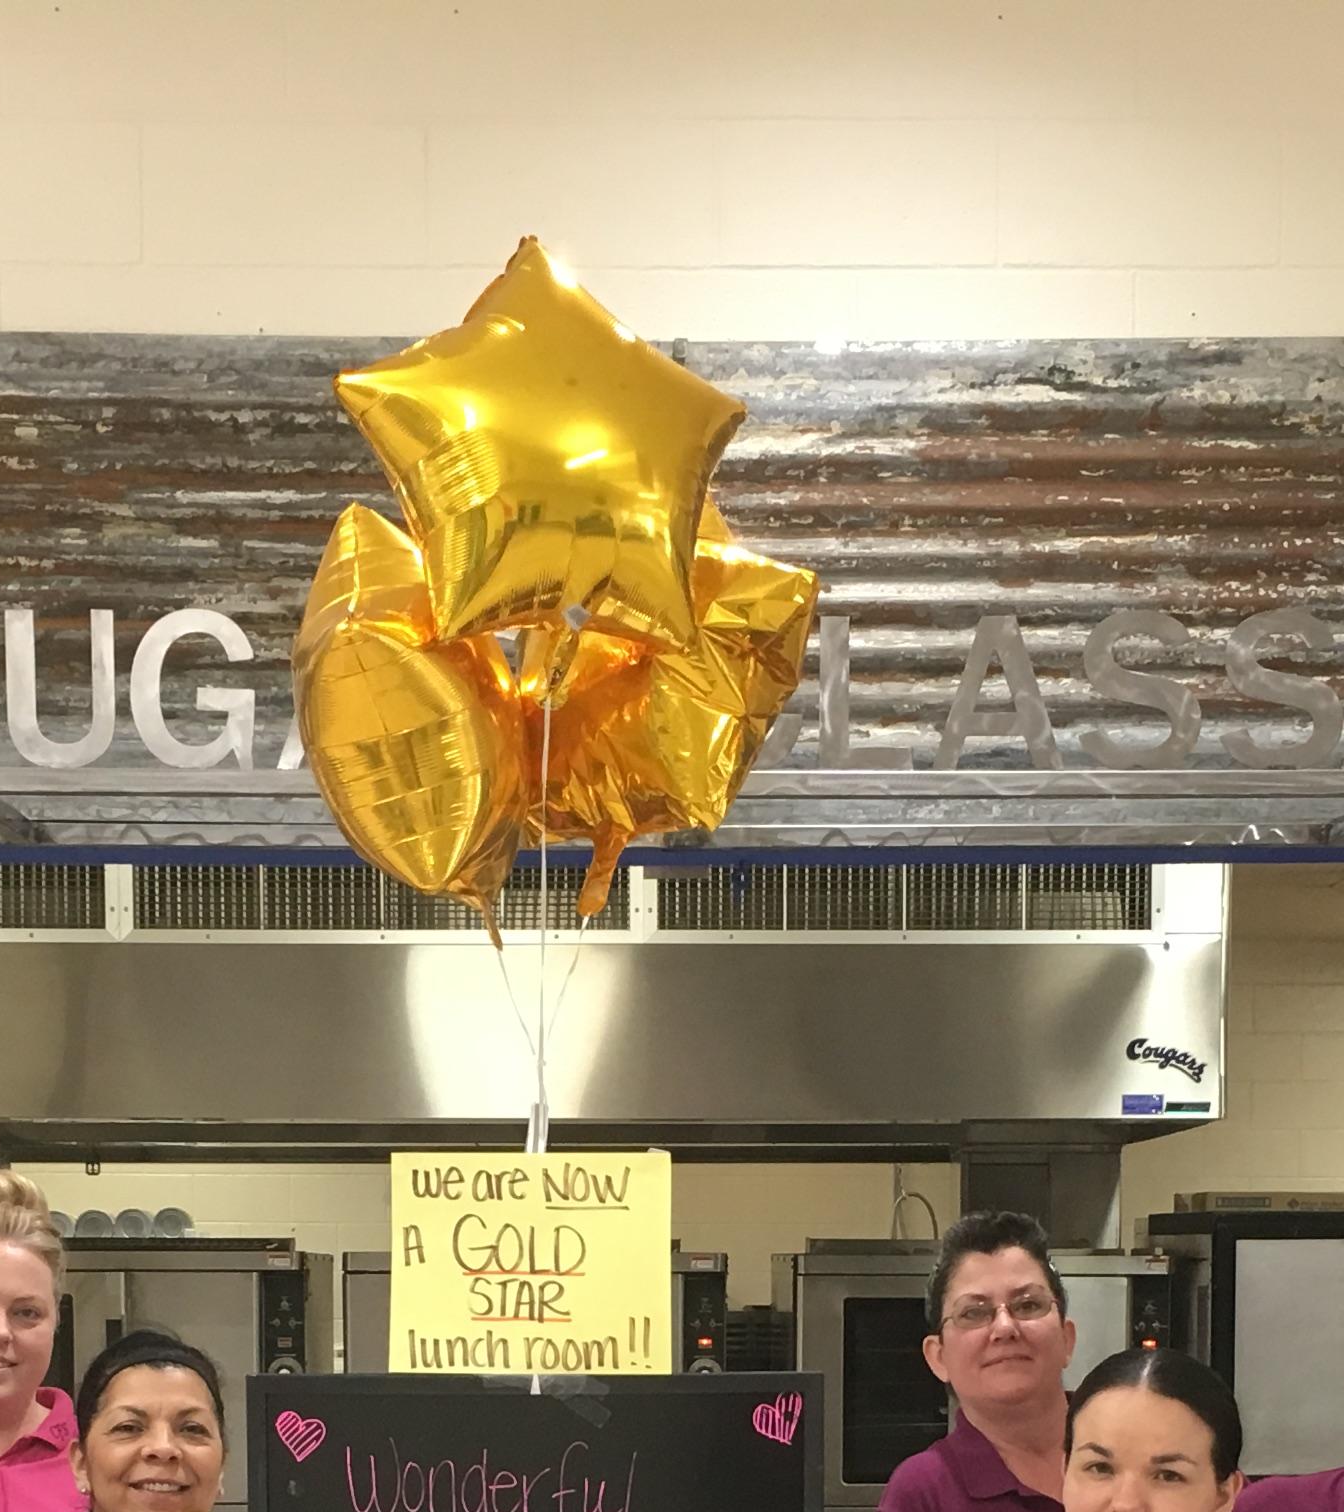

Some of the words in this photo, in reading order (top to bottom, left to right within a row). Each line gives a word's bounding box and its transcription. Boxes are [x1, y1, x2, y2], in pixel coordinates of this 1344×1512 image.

[1126, 1038, 1207, 1083] Cougars
[472, 1167, 529, 1201] are
[542, 1163, 631, 1204] NOW
[402, 1224, 426, 1267] A
[452, 1213, 587, 1276] GOLD
[468, 1277, 571, 1323] STAR
[409, 1329, 510, 1370] lunch
